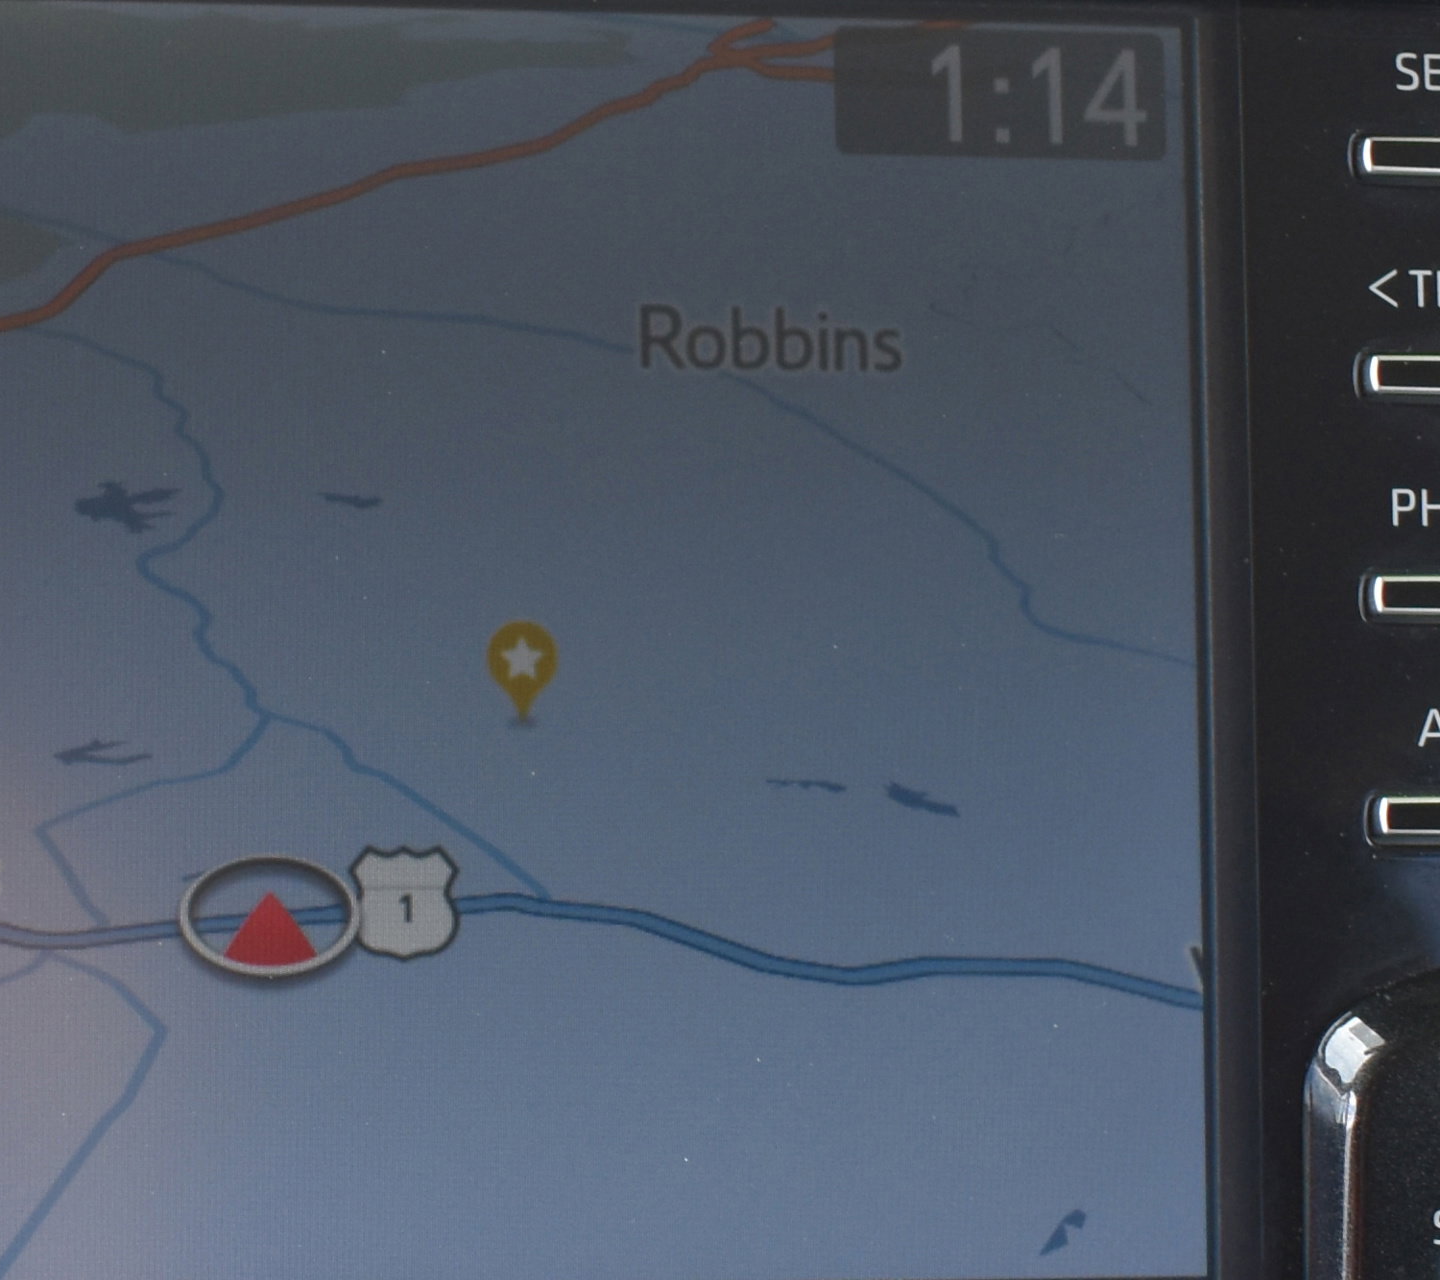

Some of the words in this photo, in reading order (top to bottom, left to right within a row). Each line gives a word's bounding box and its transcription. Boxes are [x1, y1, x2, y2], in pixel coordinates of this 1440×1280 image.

[929, 43, 1148, 147] 1:14
[638, 304, 904, 374] Robbins
[398, 893, 414, 923] 1
